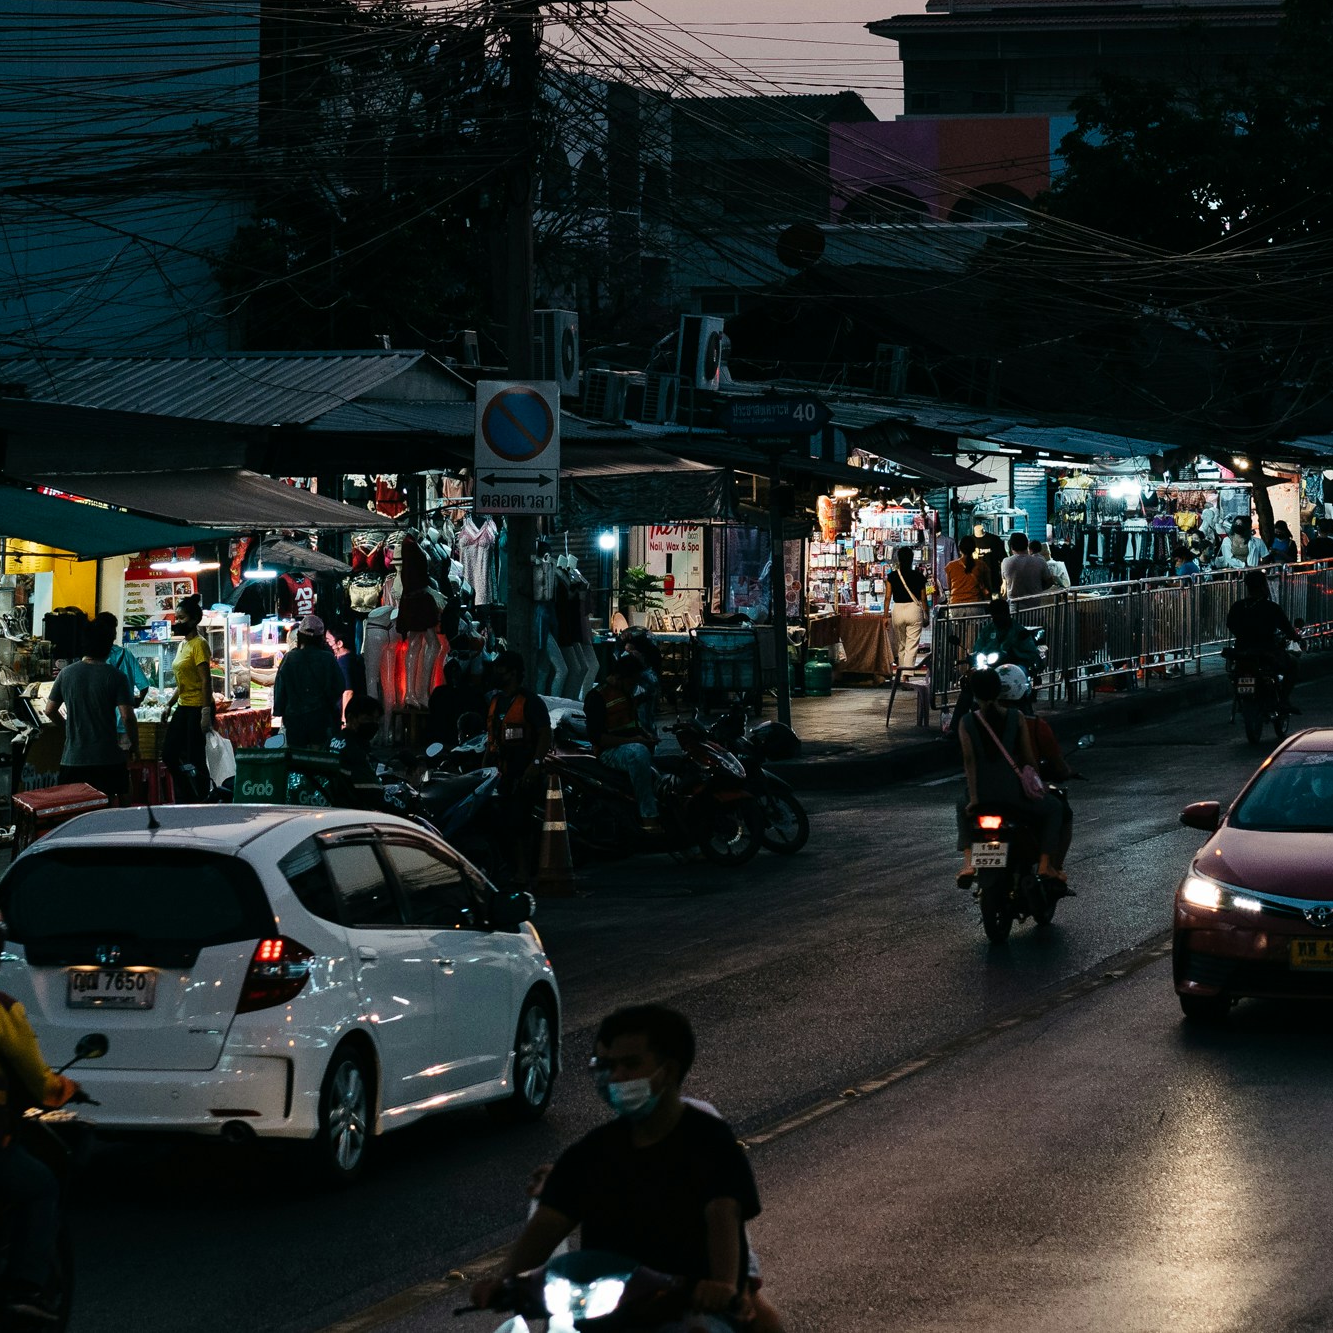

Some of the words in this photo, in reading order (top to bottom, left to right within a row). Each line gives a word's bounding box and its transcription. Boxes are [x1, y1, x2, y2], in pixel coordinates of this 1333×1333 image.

[792, 403, 816, 422] 40
[481, 494, 553, 508] ตลอดเวลา
[649, 542, 664, 552] Nail,
[666, 542, 679, 551] Wax
[681, 542, 686, 551] &
[688, 542, 699, 553] Spa
[242, 779, 274, 796] Grab
[298, 789, 327, 807] Grab
[105, 973, 146, 991] 7650
